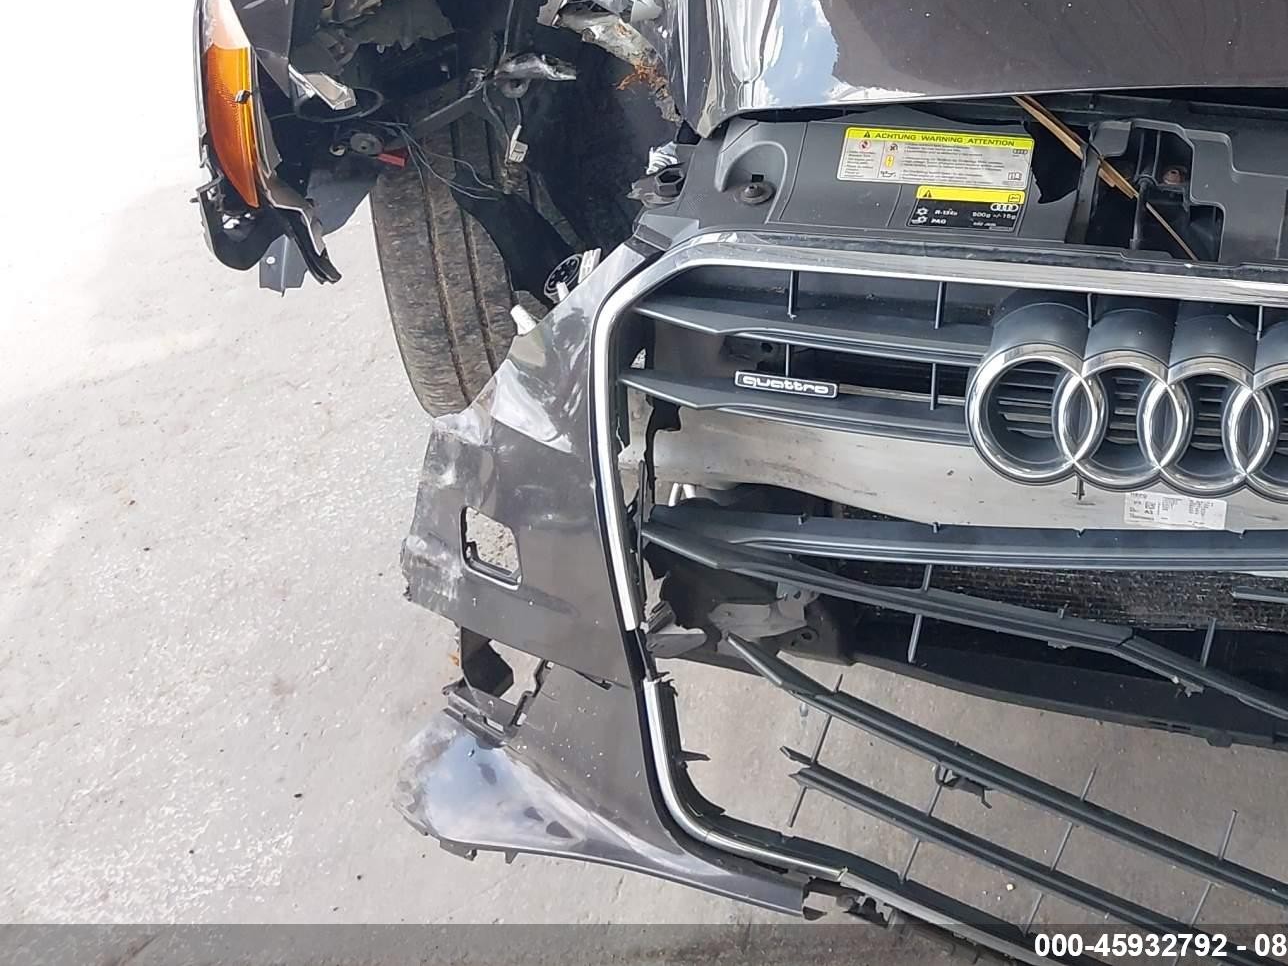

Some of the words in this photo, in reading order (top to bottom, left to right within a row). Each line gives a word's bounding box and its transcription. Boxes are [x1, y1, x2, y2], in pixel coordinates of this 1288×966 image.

[875, 132, 917, 142] ACHTUNG
[921, 135, 963, 145] WARNING
[967, 138, 1015, 147] ATTENTION
[742, 375, 829, 395] quattro
